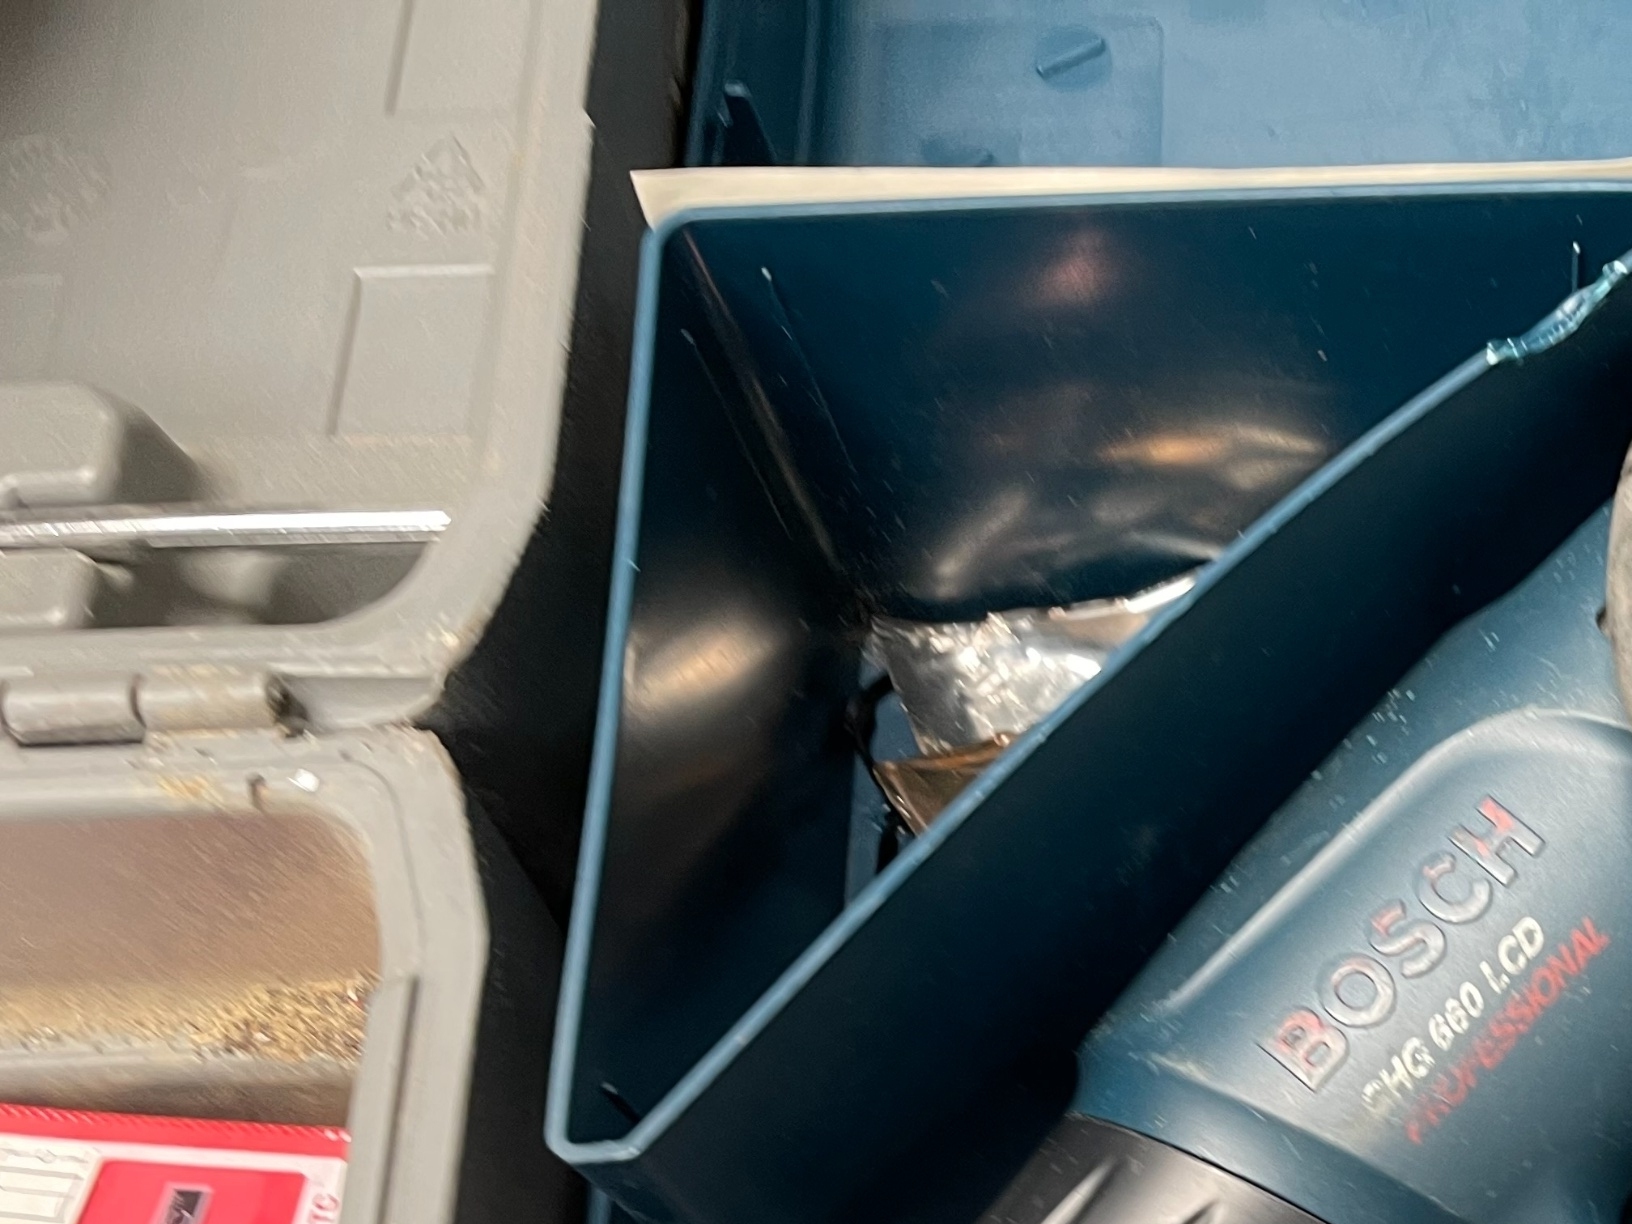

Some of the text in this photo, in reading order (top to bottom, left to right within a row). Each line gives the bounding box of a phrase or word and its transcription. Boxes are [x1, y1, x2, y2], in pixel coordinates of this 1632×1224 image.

[1256, 795, 1546, 1094] BOSCH
[1428, 980, 1485, 1052] 660
[1479, 915, 1546, 994] LCD
